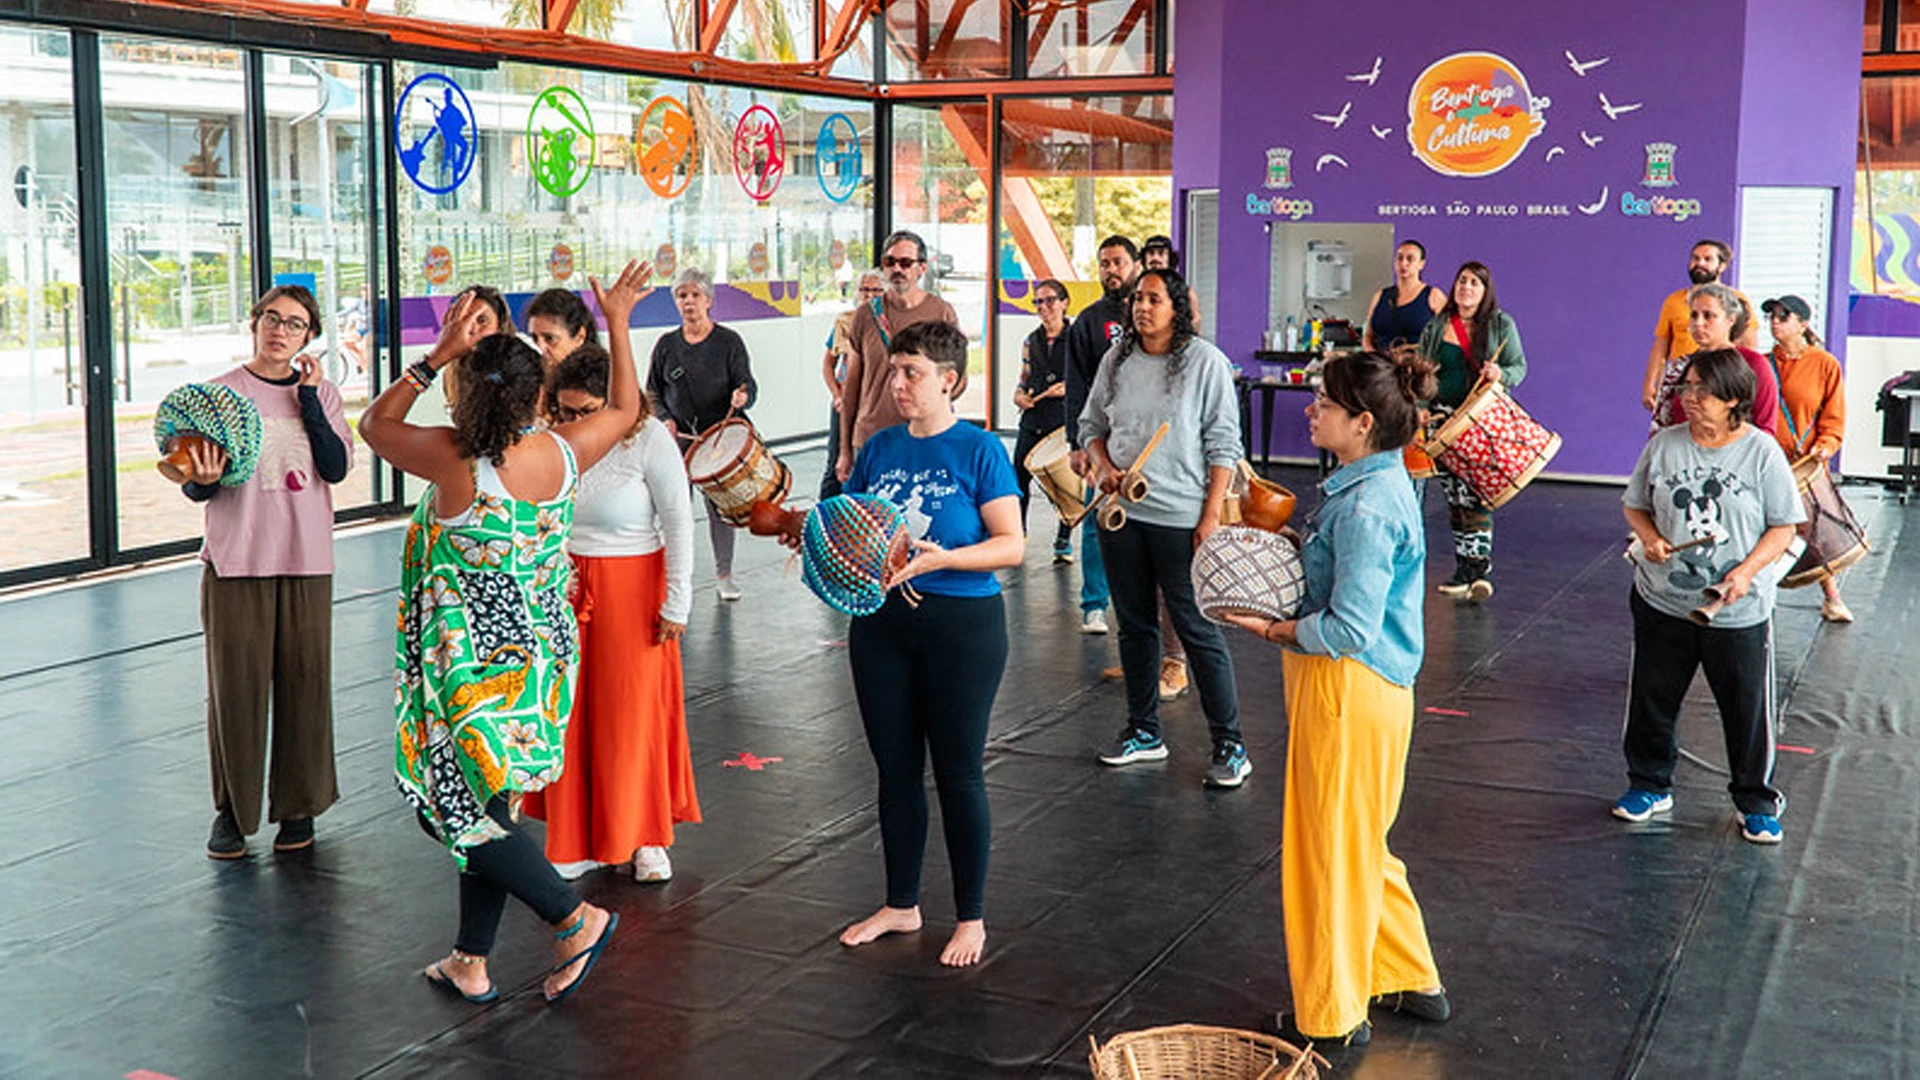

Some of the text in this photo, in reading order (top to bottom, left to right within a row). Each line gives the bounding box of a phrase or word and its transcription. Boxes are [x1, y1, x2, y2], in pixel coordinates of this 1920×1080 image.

[1427, 122, 1511, 152] Cultura
[1246, 193, 1313, 220] Bertioga
[1378, 200, 1571, 216] BERTIOGA SÃO PAULO BRASIL
[1621, 191, 1701, 221] Bertioga
[1666, 466, 1751, 496] MICKEY
